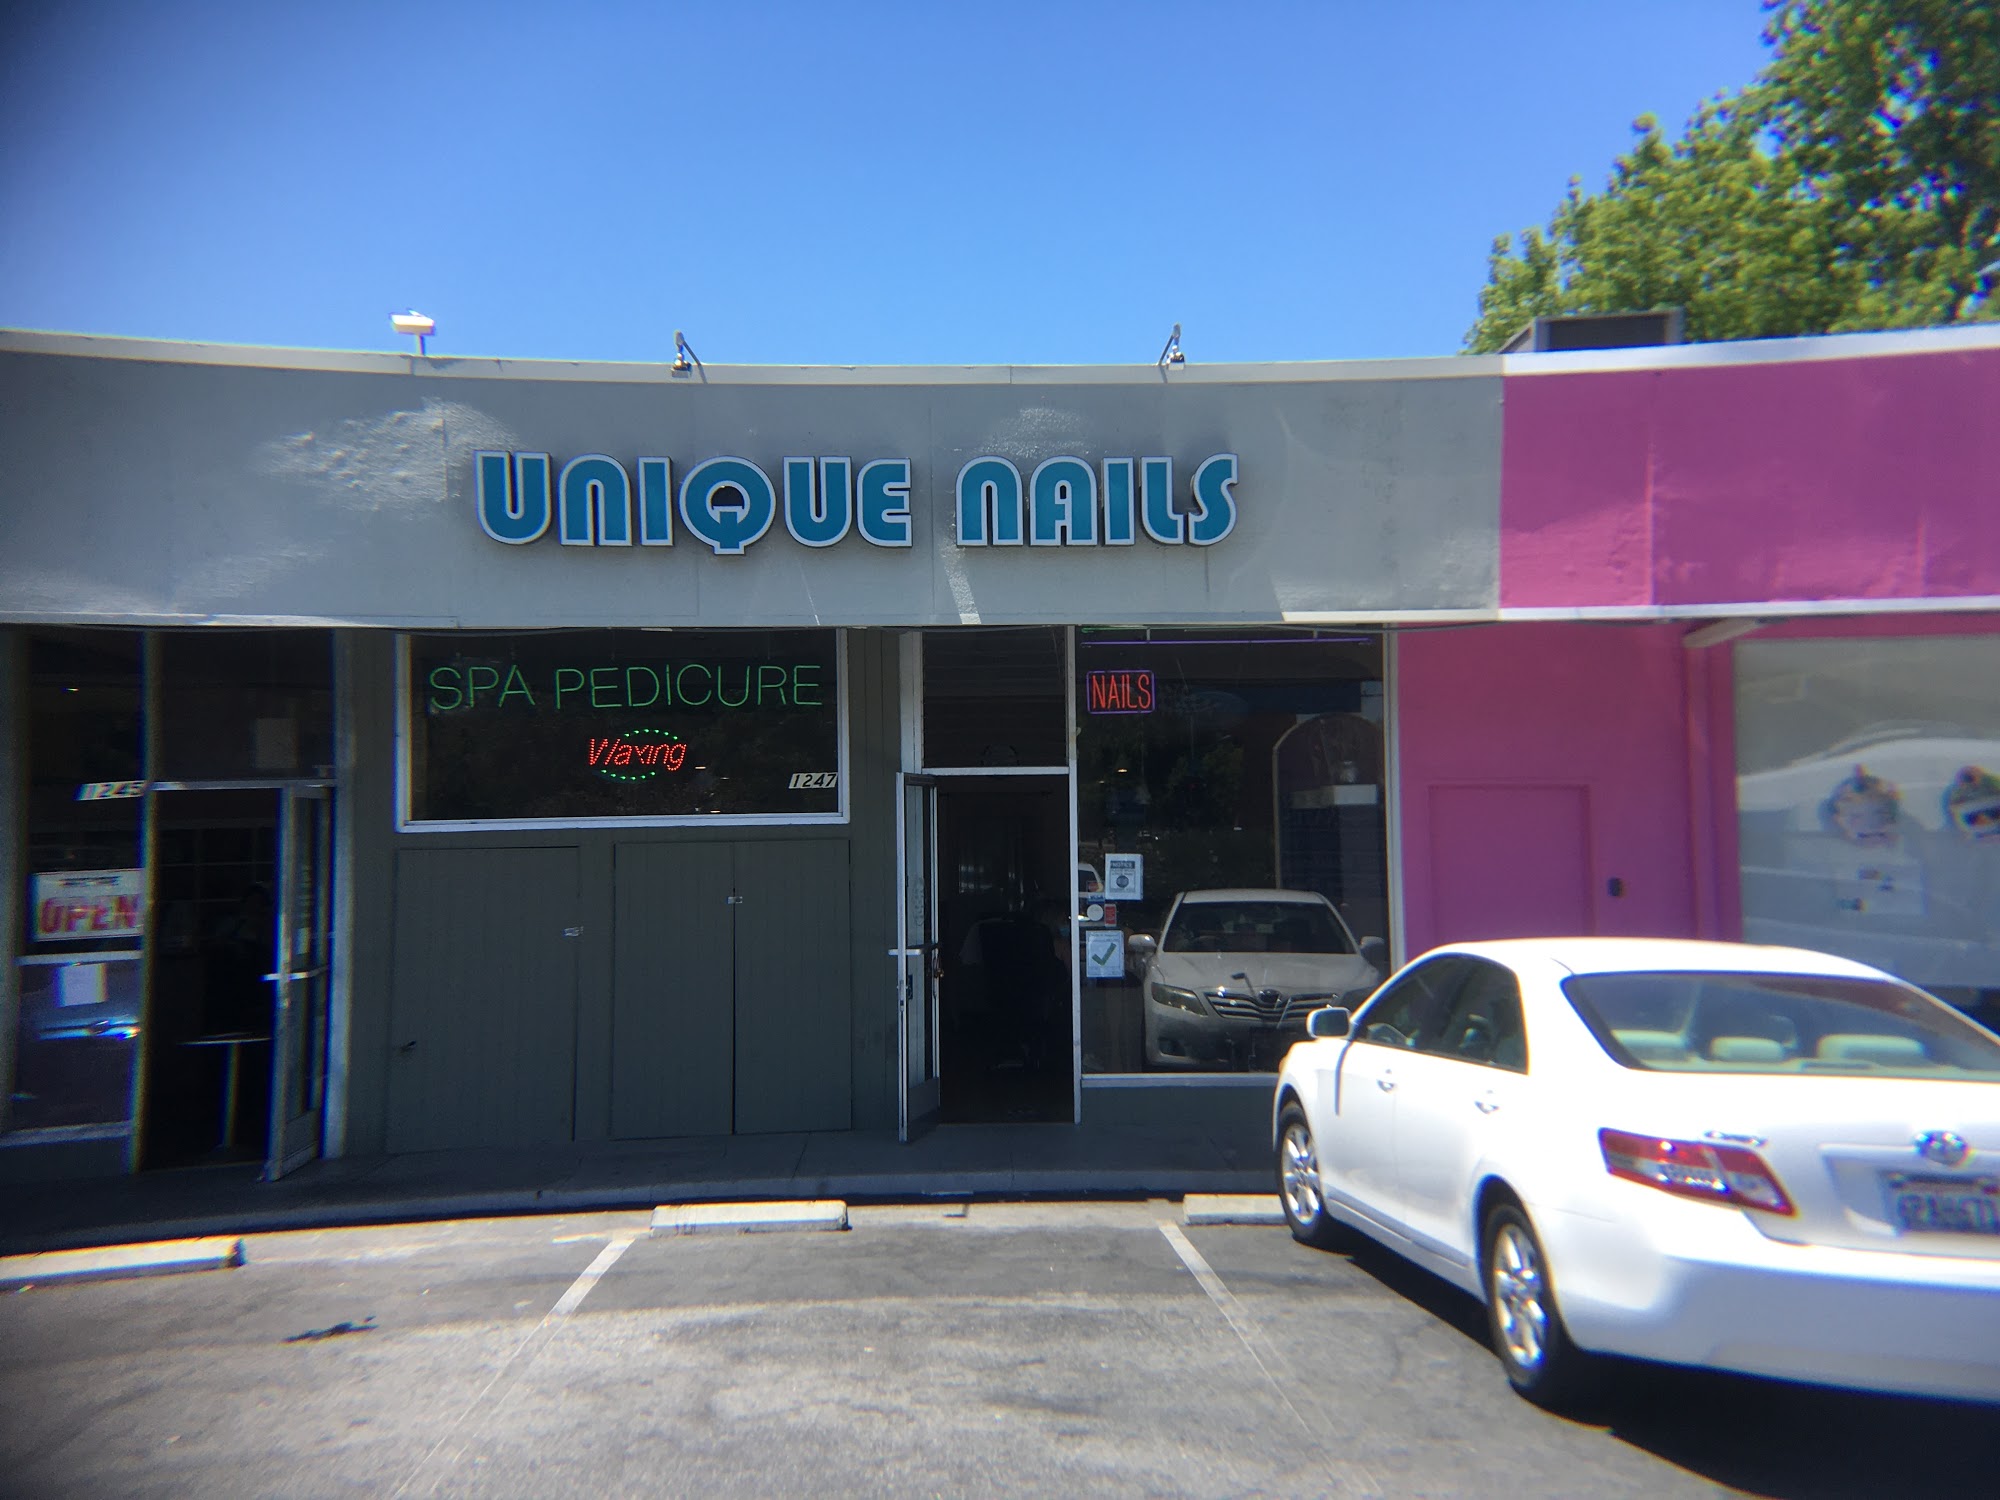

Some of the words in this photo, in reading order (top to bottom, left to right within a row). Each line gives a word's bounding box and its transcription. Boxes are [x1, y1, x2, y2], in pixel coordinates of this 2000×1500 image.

[473, 450, 913, 555] UNIQUE
[955, 453, 1239, 547] NAILS
[429, 664, 536, 711] SPA
[554, 663, 823, 710] PEDICURE
[1090, 673, 1152, 711] NAILS
[588, 737, 688, 772] Waxing
[793, 773, 837, 788] 1247
[40, 895, 141, 933] OPEN
